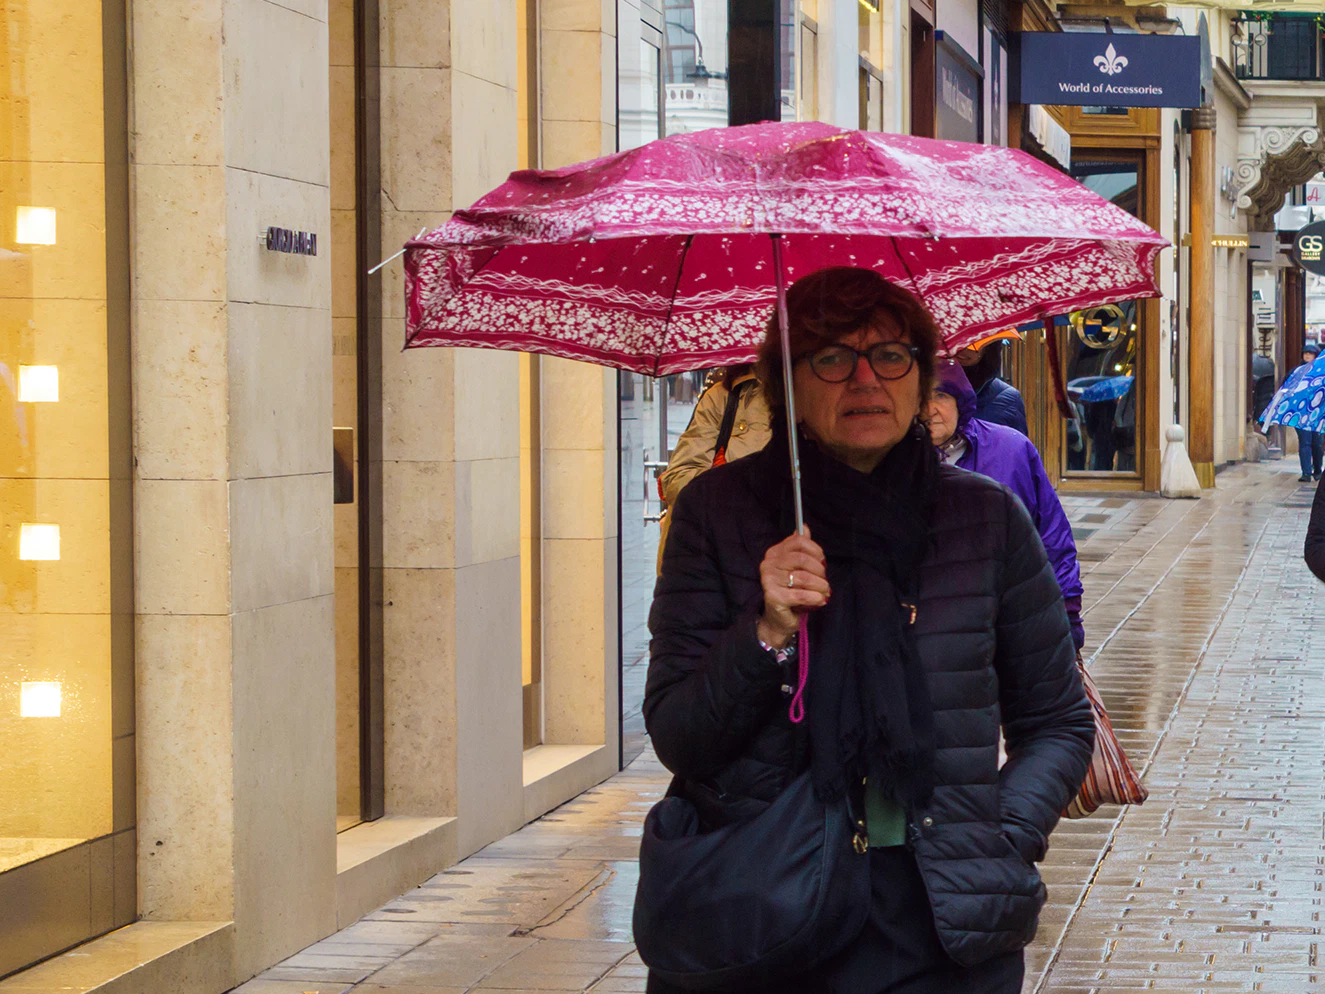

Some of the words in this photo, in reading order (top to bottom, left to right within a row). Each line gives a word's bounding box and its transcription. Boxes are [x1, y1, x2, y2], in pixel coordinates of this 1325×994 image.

[1059, 82, 1090, 93] World
[1093, 83, 1104, 93] of
[1105, 84, 1163, 95] Accessories
